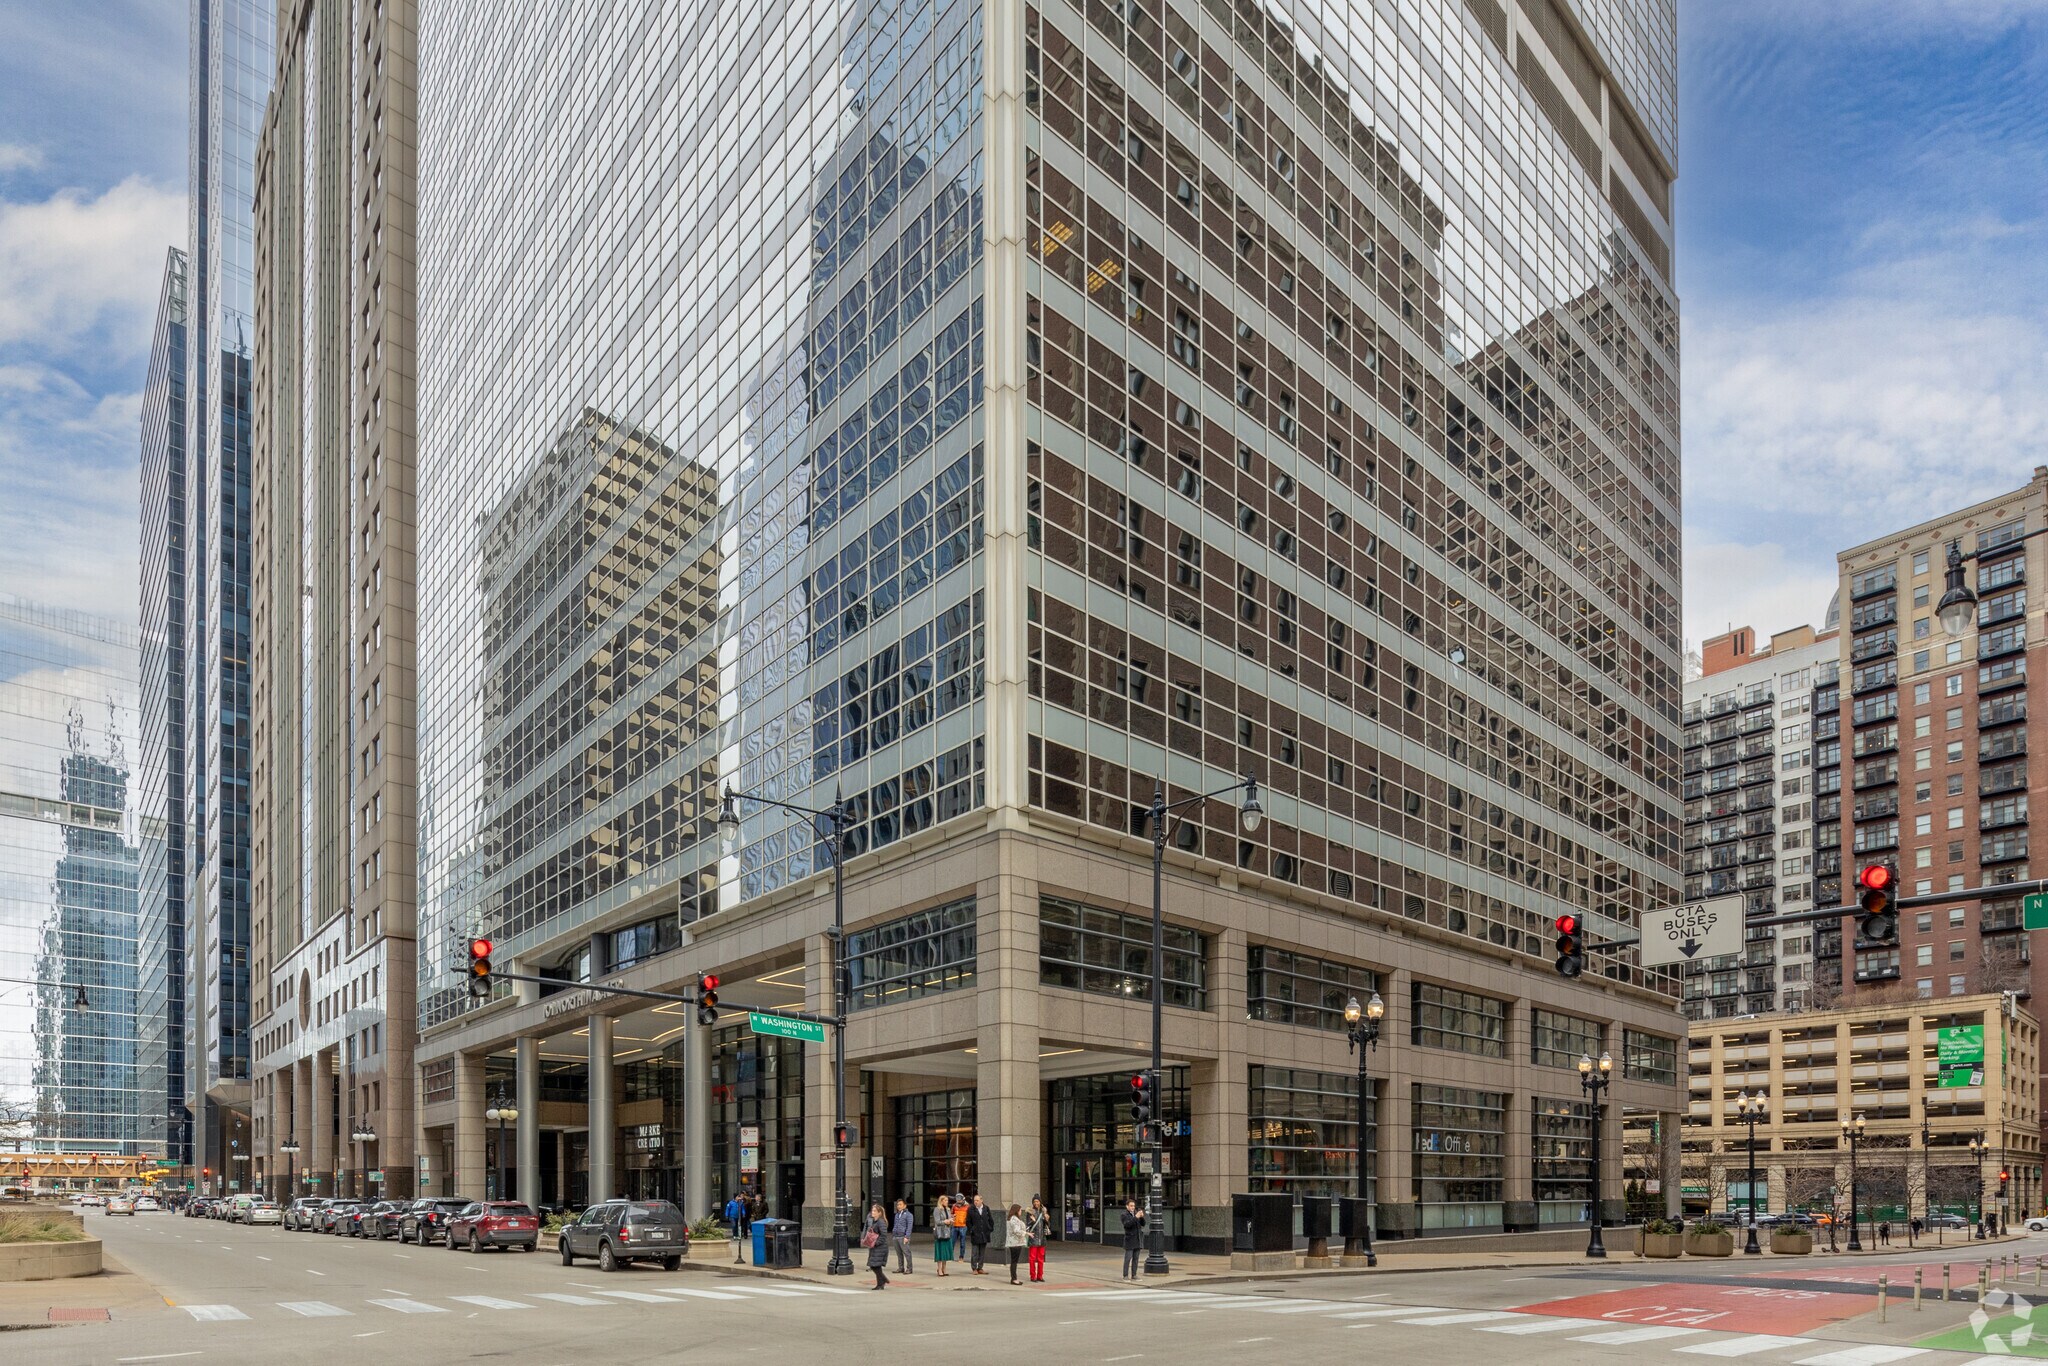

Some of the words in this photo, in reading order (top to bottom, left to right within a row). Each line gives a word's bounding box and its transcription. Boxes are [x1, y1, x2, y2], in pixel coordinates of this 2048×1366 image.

[1675, 904, 1706, 918] CTA
[2033, 899, 2042, 909] N
[1663, 913, 1718, 931] BUSES
[1668, 924, 1713, 941] ONLY
[761, 1017, 813, 1032] WASHINGTON
[639, 1124, 664, 1137] MARKE
[1444, 1135, 1471, 1152] Offie
[1602, 1306, 1734, 1325] CTA
